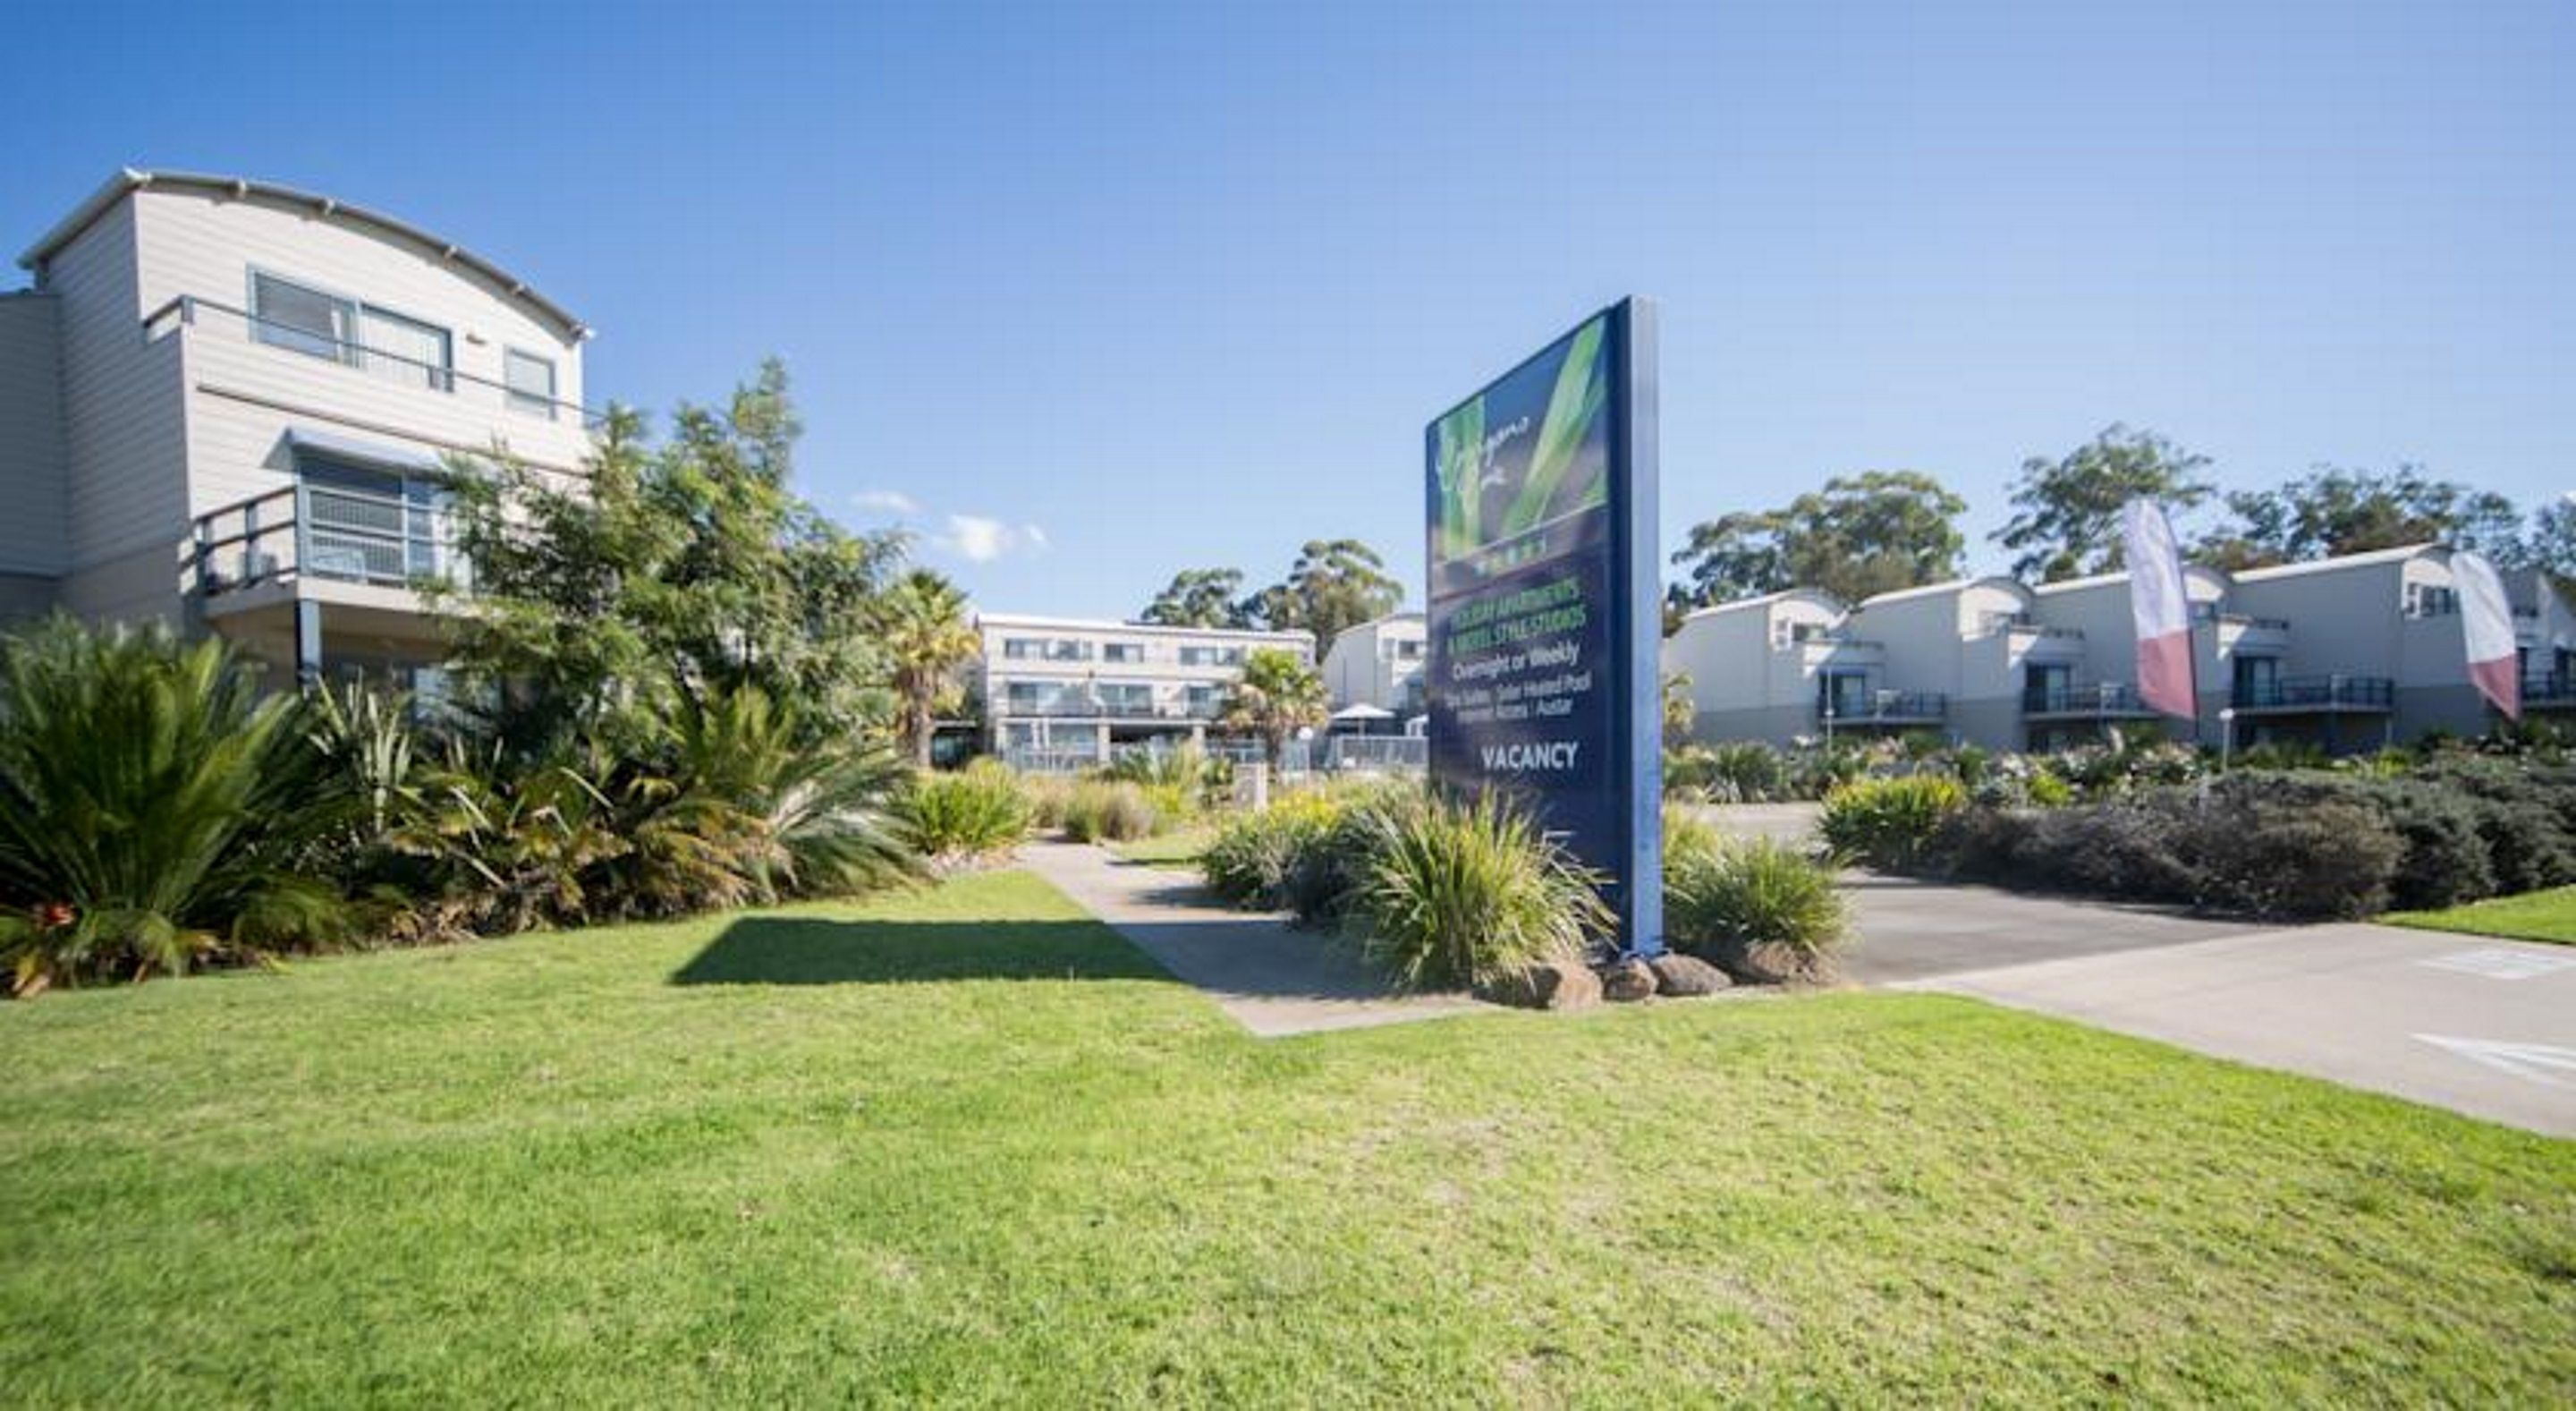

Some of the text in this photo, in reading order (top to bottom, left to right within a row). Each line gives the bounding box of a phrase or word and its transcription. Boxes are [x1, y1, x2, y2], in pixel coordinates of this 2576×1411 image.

[1453, 639, 1580, 682] Overnight or Weekly
[1480, 741, 1580, 771] VACANCY
